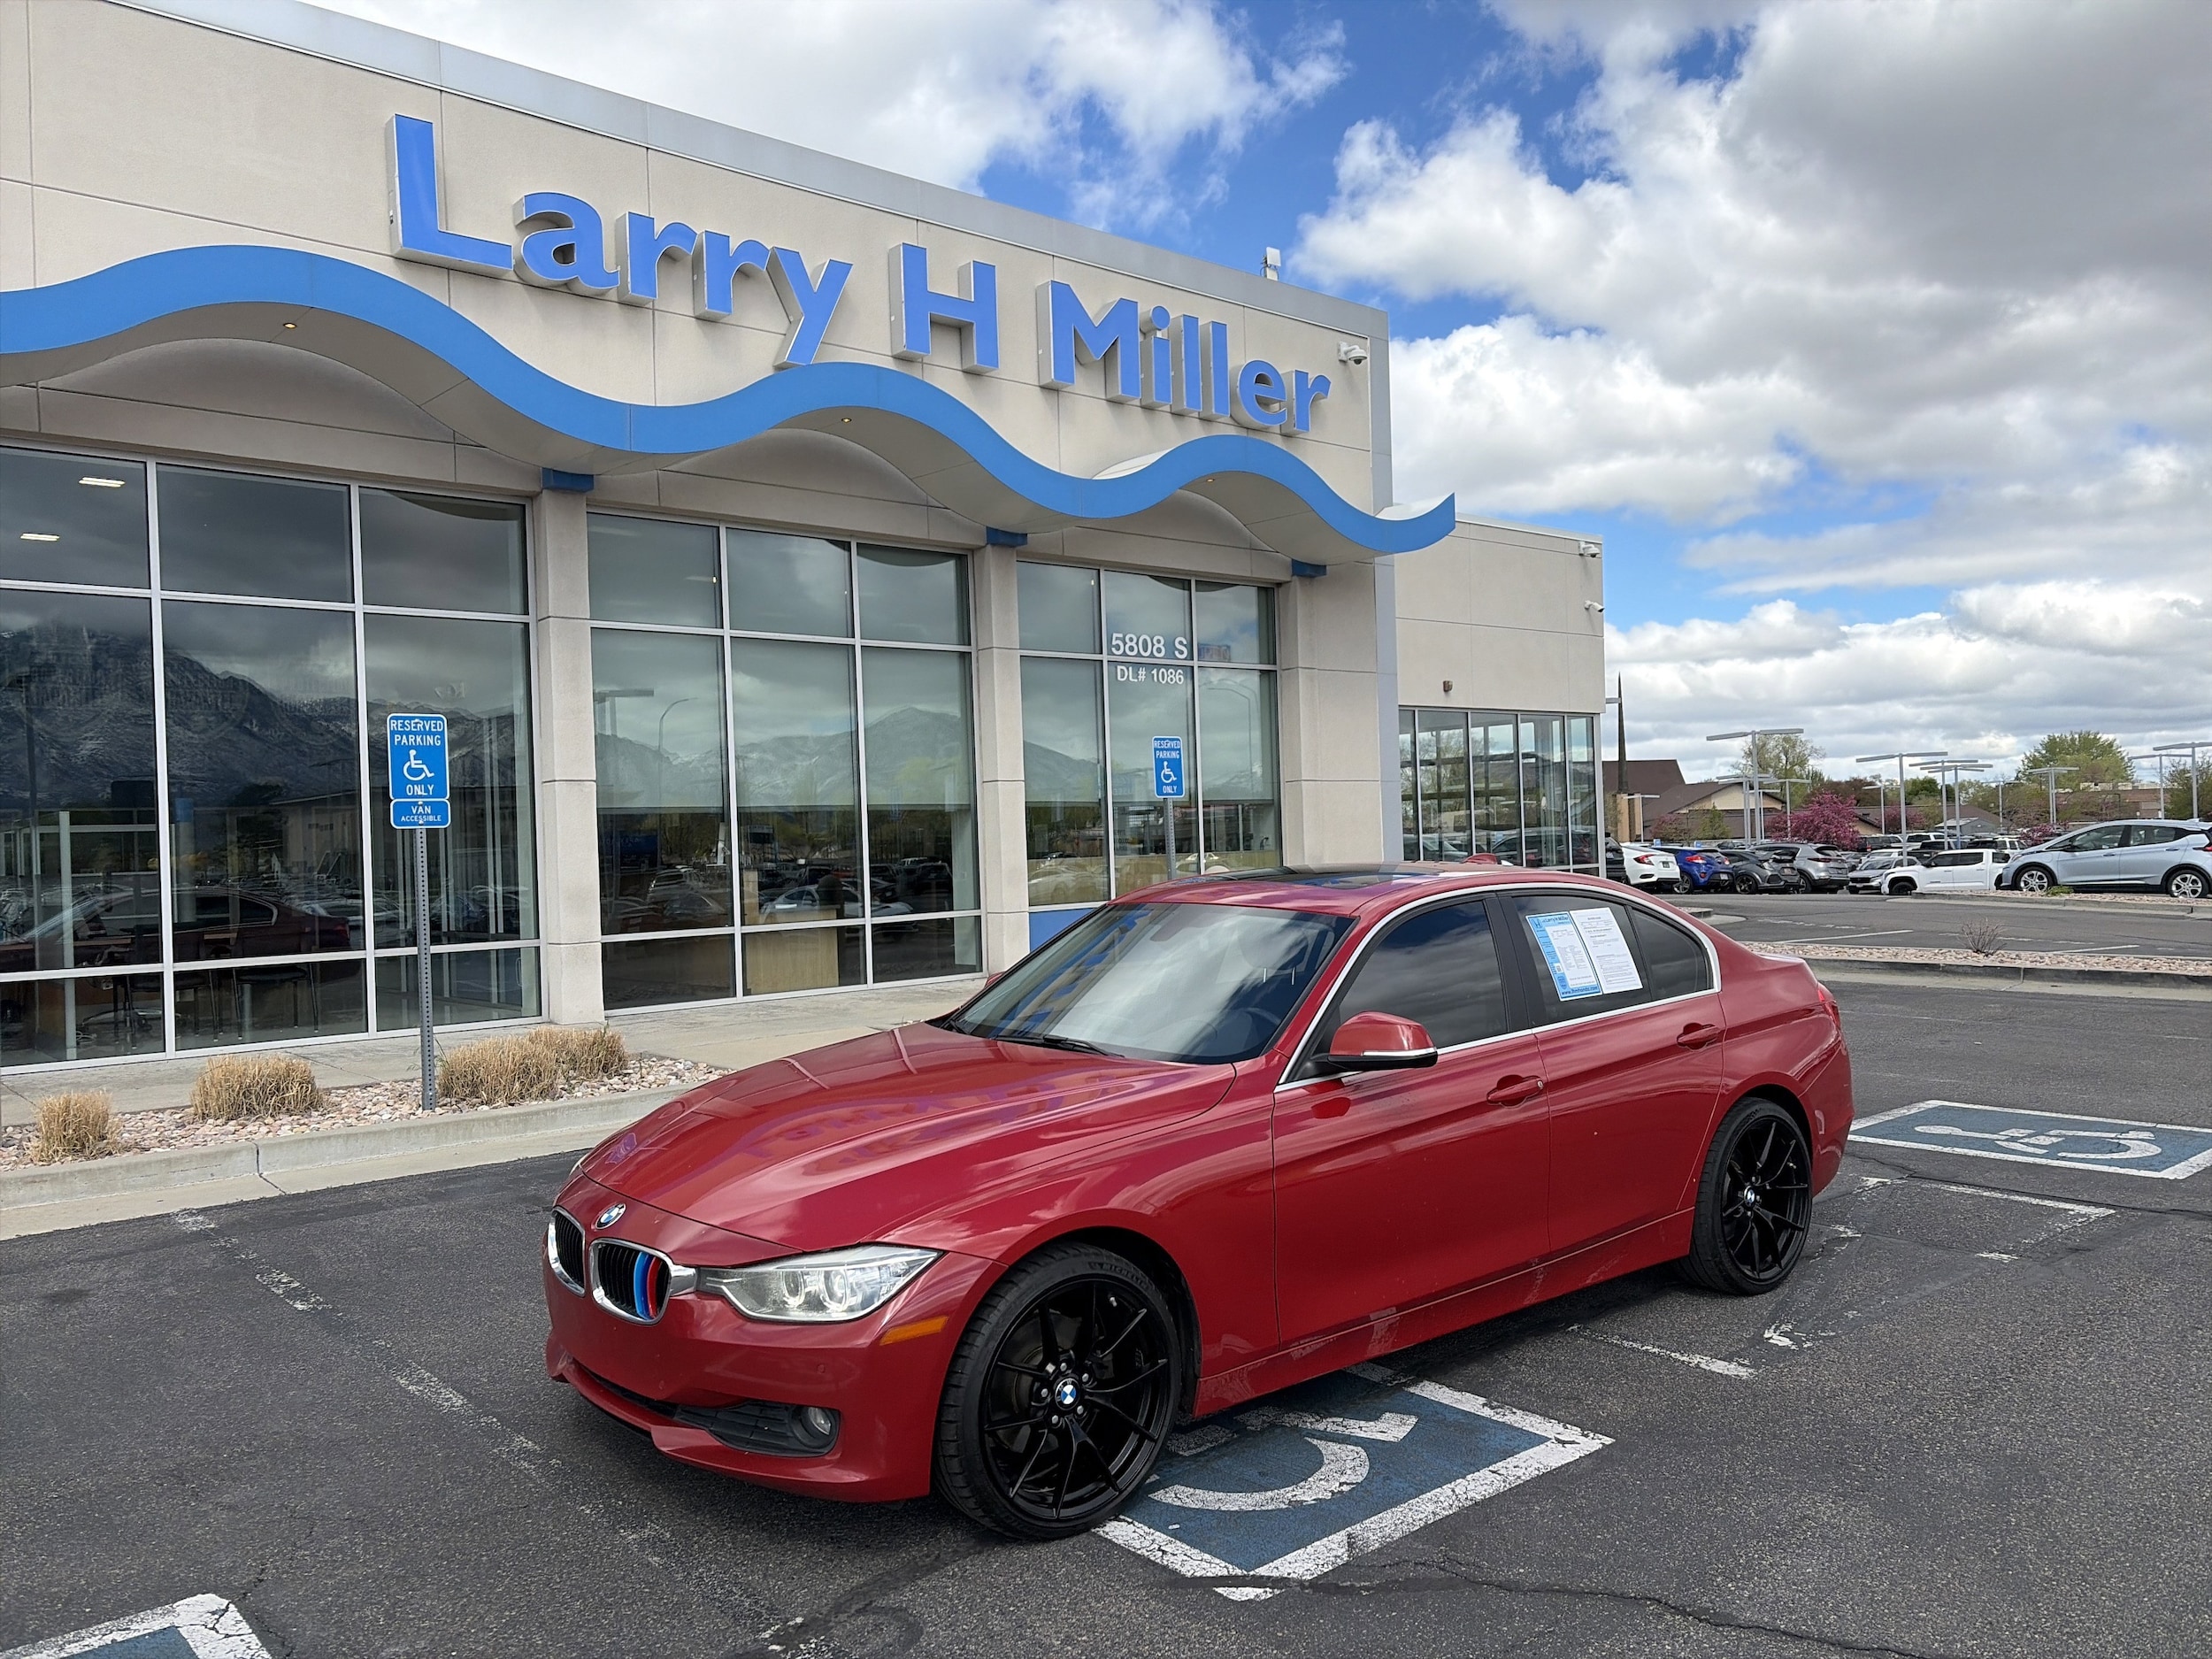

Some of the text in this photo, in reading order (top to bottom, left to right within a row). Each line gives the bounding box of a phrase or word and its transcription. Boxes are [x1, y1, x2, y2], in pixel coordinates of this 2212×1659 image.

[388, 113, 1332, 435] Larry H Miller
[1111, 633, 1165, 657] 5808
[1174, 636, 1188, 659] S
[1117, 665, 1184, 685] DL# 1086
[390, 719, 443, 732] RESERVED
[394, 734, 442, 746] PARKING
[1154, 740, 1181, 749] RESERVED
[1156, 750, 1180, 759] PARKING
[406, 784, 434, 795] ONLY
[1162, 785, 1178, 794] ONLY
[411, 806, 432, 815] VAN
